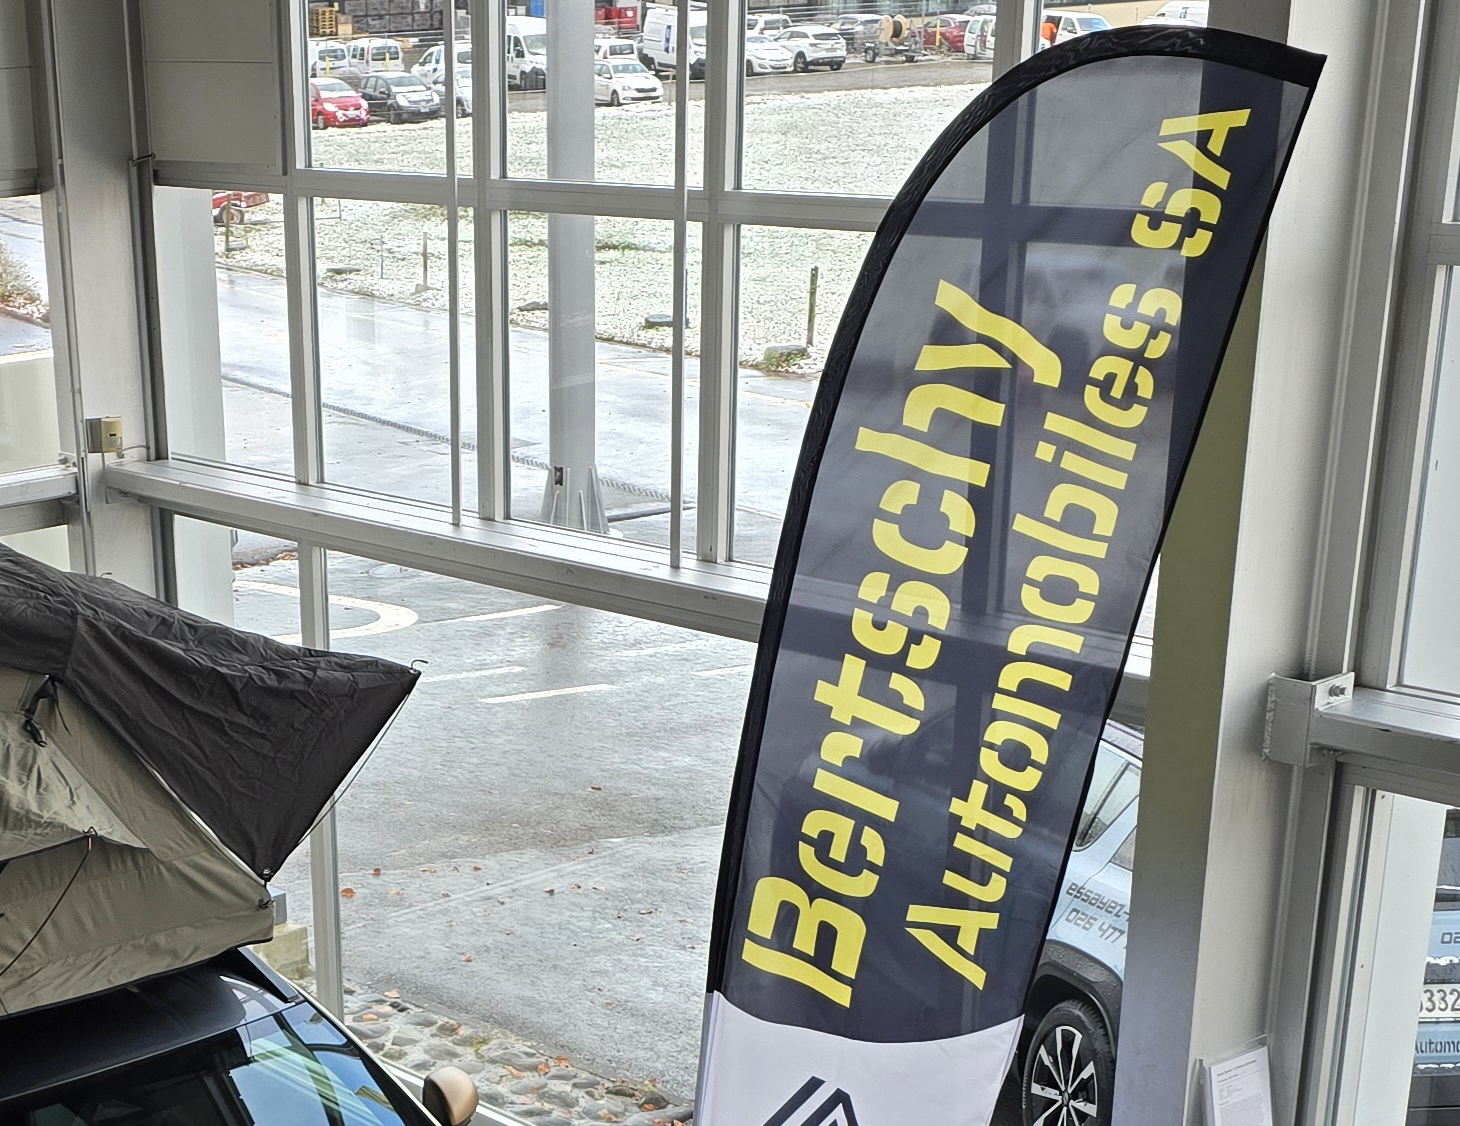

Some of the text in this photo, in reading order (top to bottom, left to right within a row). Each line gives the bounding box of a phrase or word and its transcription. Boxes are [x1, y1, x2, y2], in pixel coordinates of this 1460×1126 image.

[742, 279, 1062, 1008] Bertschy
[904, 108, 1251, 990] Automobiles SA
[1065, 907, 1126, 943] 026 477
[1066, 882, 1129, 922] essayez-
